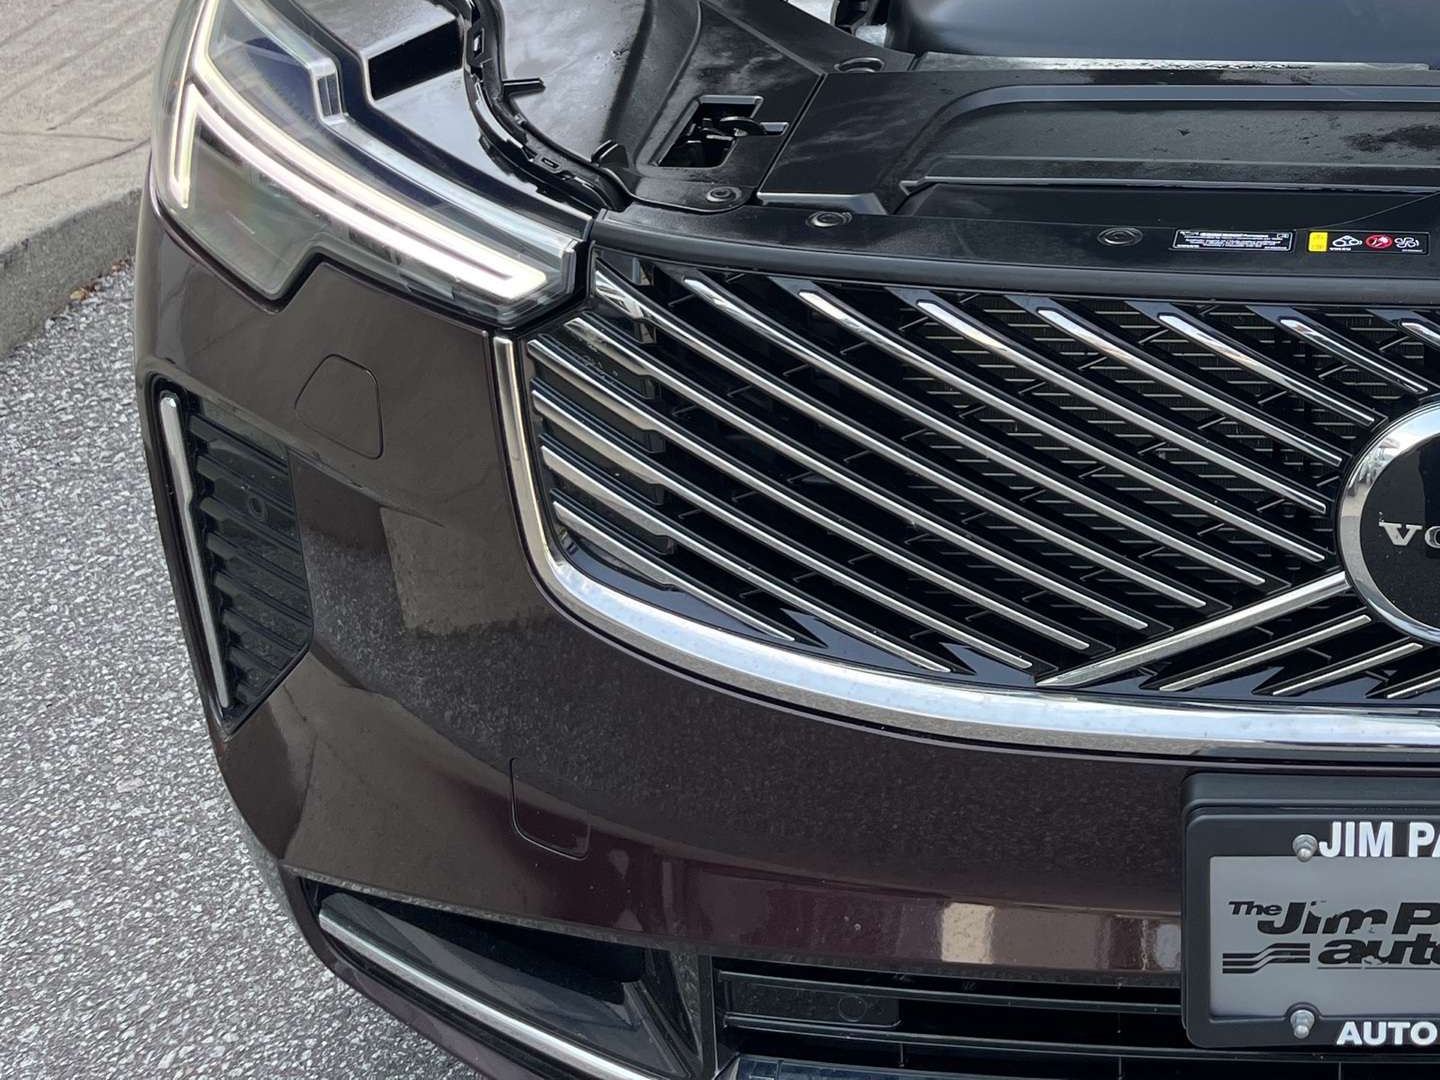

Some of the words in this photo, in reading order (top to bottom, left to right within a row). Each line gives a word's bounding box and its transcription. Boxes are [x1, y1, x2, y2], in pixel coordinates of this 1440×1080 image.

[1318, 822, 1393, 858] JIM
[1228, 900, 1282, 916] The
[1257, 900, 1390, 935] Jim
[1336, 1021, 1437, 1046] AUTO
